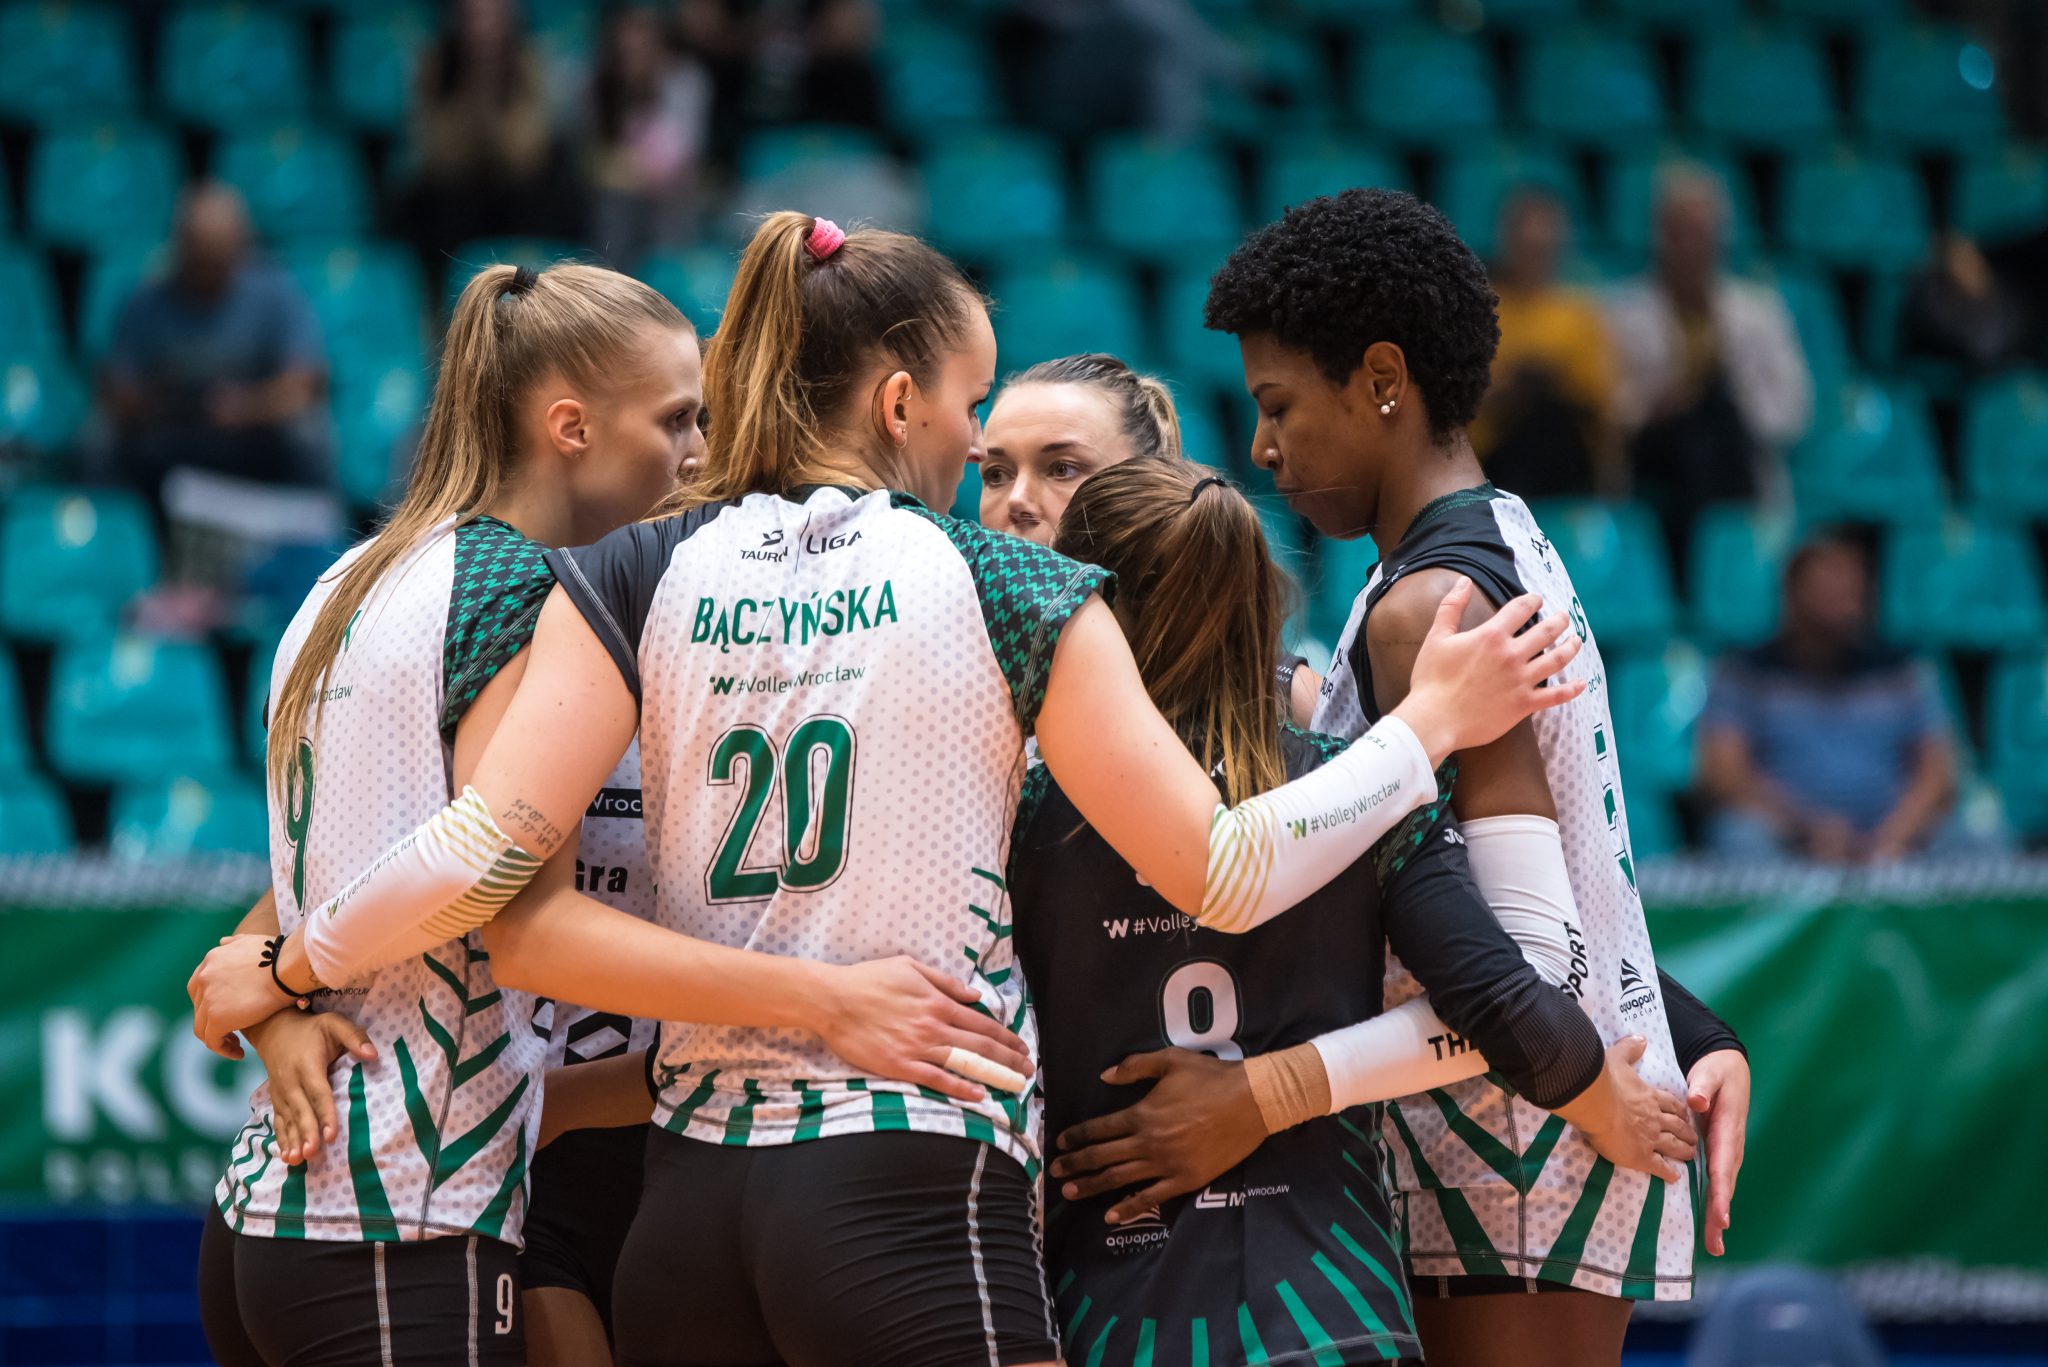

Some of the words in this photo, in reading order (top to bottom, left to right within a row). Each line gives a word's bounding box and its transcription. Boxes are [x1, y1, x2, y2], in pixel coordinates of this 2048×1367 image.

[806, 531, 863, 555] LIGA
[691, 579, 898, 653] BĄCZYŃSKA
[704, 713, 858, 906] 20
[1620, 988, 1656, 1015] aquapark
[1106, 1227, 1171, 1249] aquapark
[495, 1273, 514, 1335] 9
